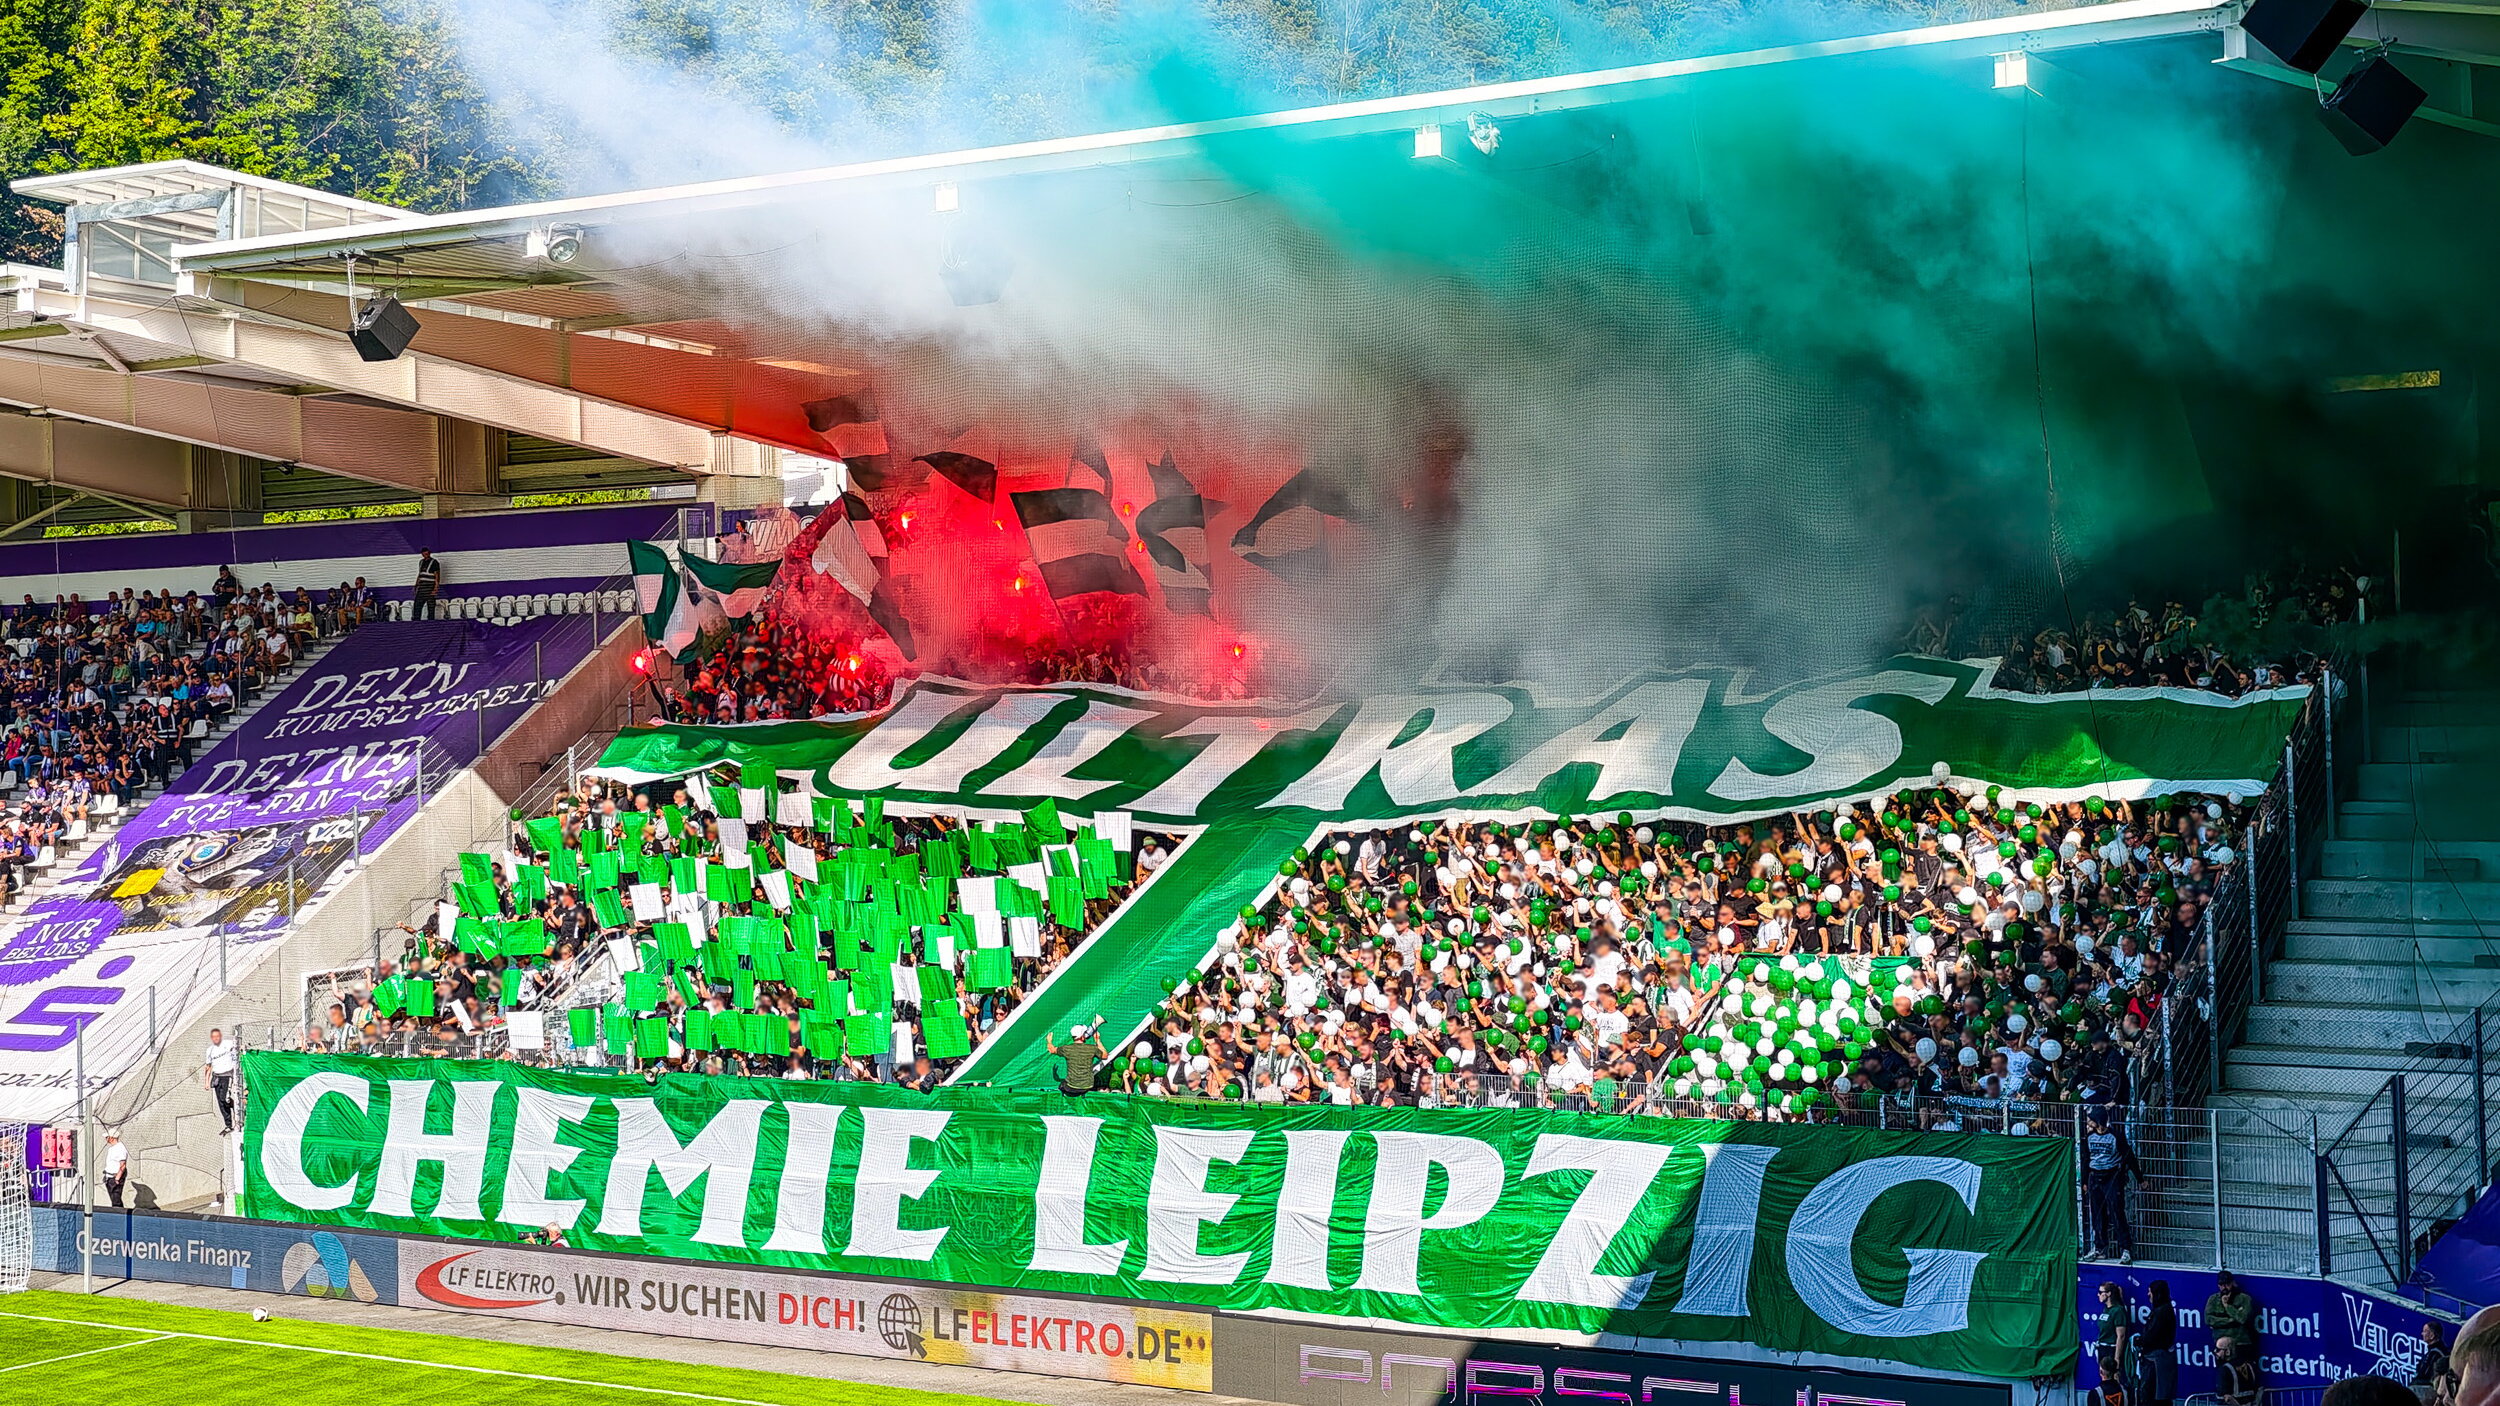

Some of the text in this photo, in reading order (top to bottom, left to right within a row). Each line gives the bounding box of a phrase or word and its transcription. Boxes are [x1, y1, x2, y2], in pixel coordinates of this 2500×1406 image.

[264, 679, 560, 740] KUMPELVEREIN
[286, 660, 478, 715] DEIN
[184, 736, 426, 801] DEINE
[828, 668, 1957, 816] ULTRAS
[2, 946, 46, 960] BEI
[27, 918, 102, 945] NUR
[260, 1071, 1990, 1338] CHEMIE LEIPZIG
[75, 1231, 252, 1269] Czerwenka Finanz
[448, 1266, 555, 1296] LF ELEKTRO
[573, 1273, 865, 1333] WIR SUCHEN DICH!
[933, 1306, 1181, 1364] LFELEKTRO.DE
